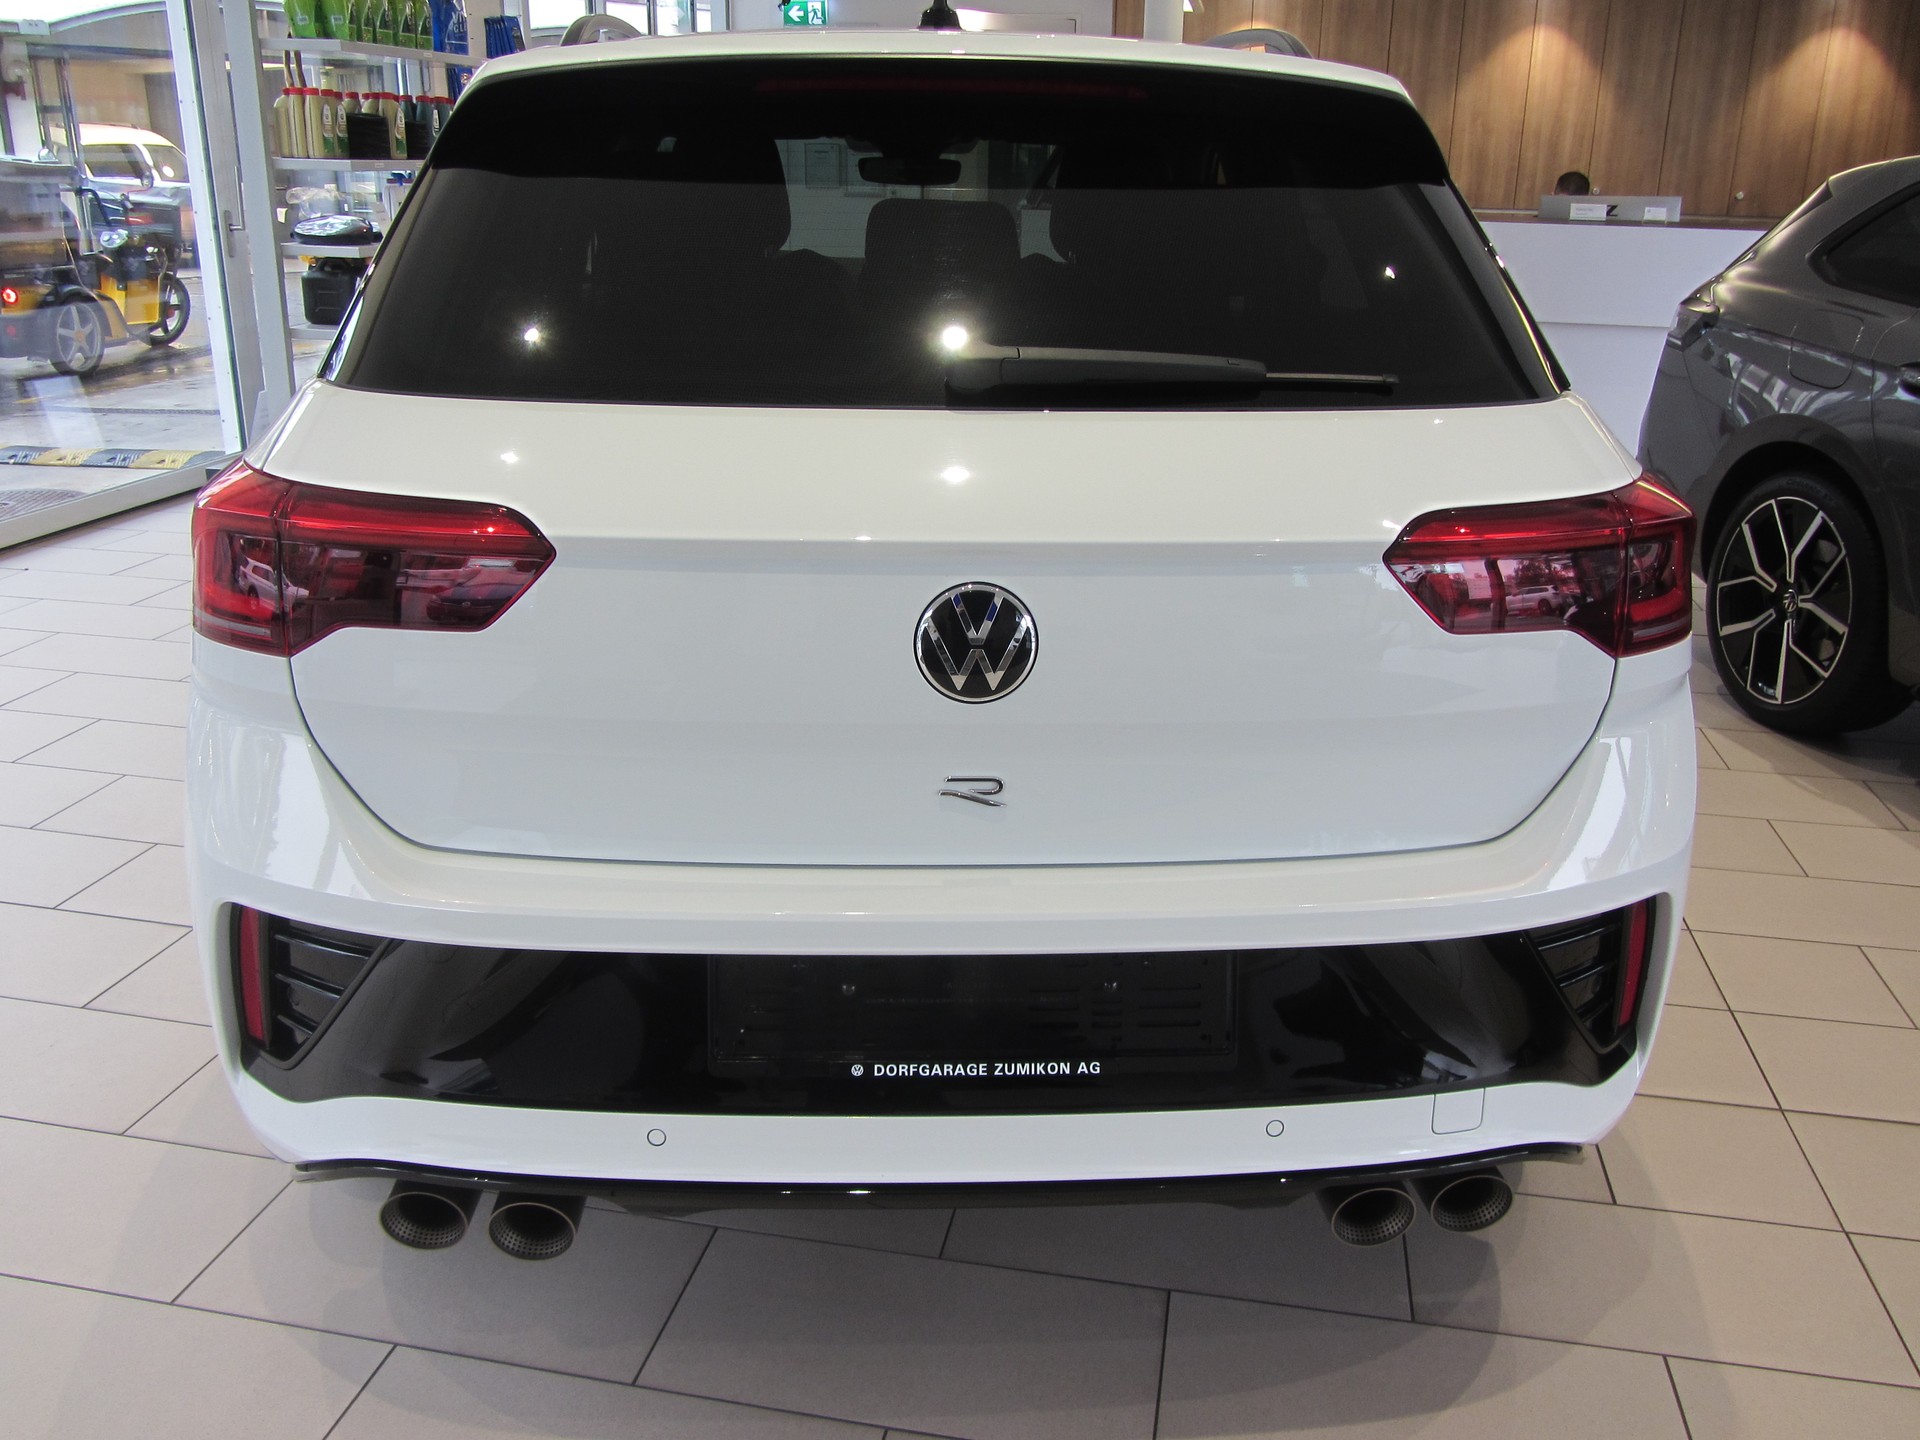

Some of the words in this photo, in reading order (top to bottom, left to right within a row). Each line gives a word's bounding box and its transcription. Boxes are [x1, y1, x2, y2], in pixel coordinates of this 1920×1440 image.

[917, 584, 1036, 700] VW
[938, 775, 1007, 808] R
[873, 1063, 988, 1077] DORFGARAGE
[993, 1062, 1071, 1077] ZUMIKON
[1077, 1061, 1101, 1075] AG
